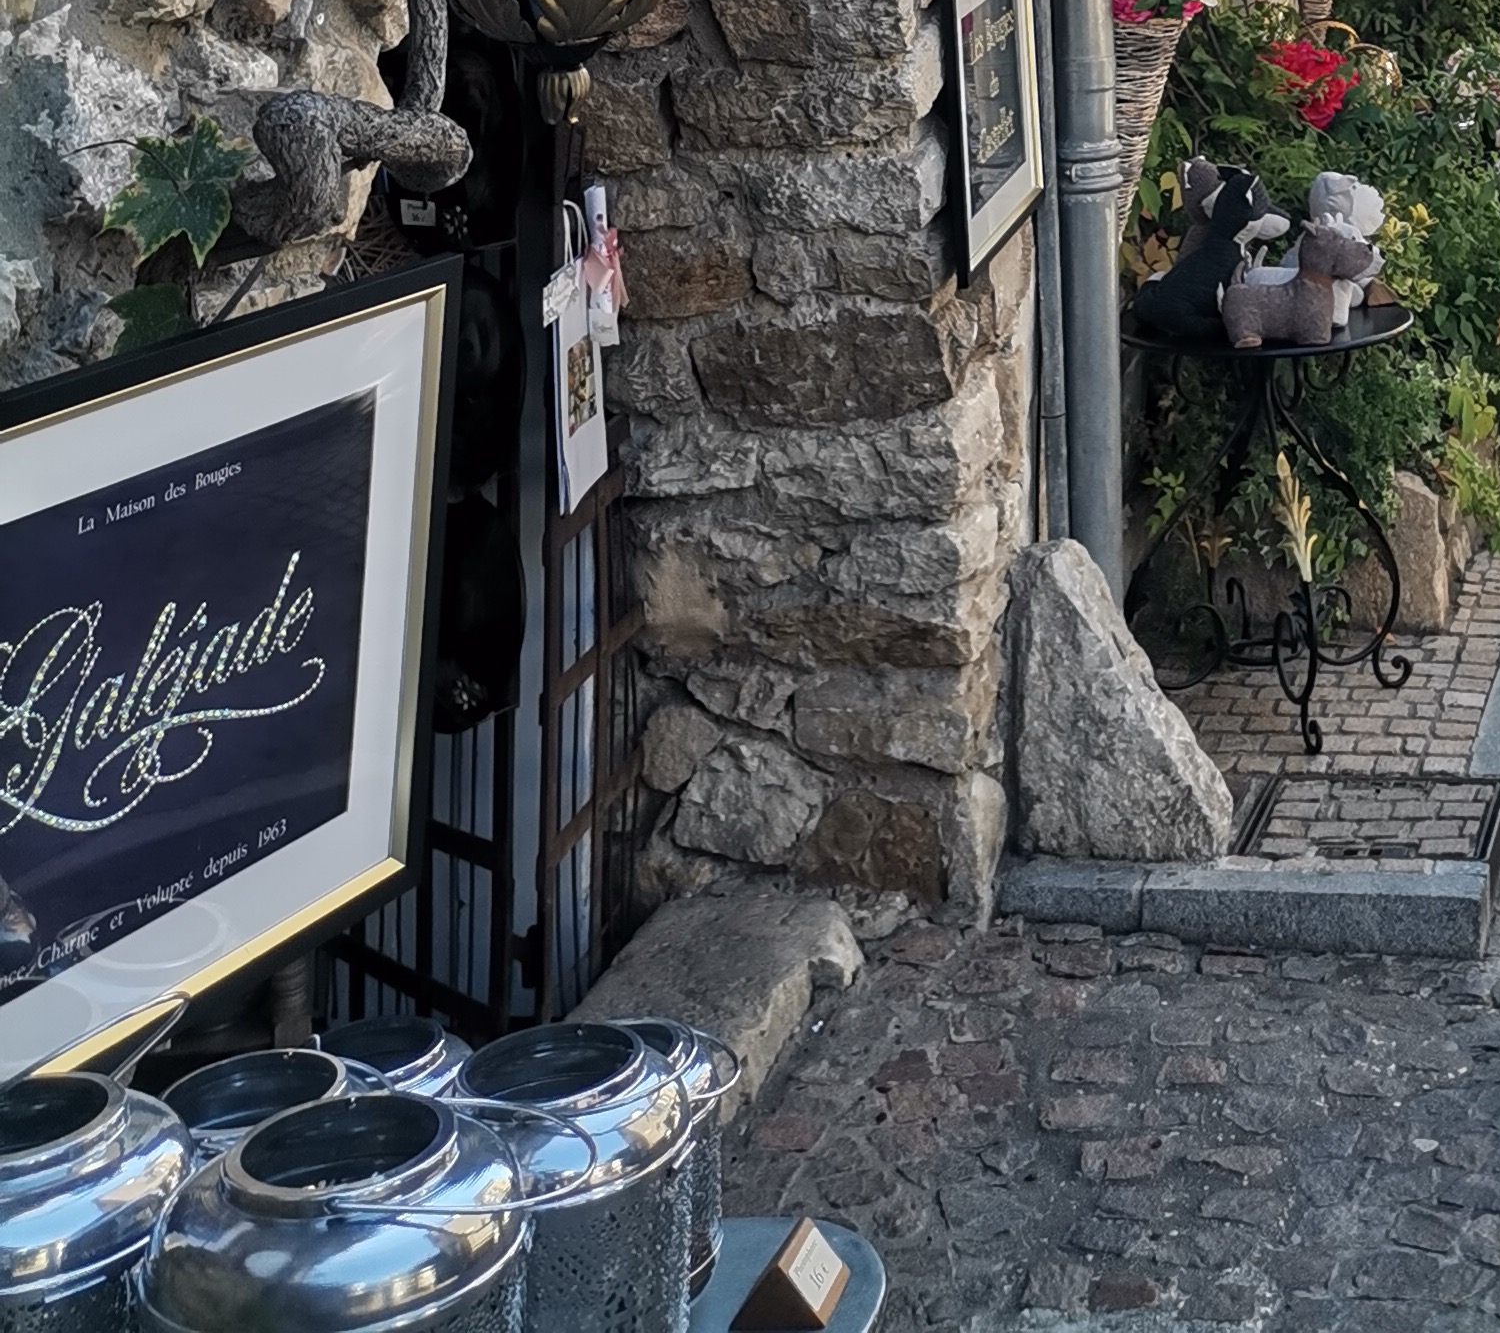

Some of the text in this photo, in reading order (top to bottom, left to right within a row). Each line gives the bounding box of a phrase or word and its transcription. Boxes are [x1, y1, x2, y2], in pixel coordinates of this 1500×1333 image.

[77, 461, 242, 535] La Maison des Bougies
[37, 925, 99, 969] Charme
[109, 910, 125, 930] et
[135, 871, 194, 914] Volupté
[203, 843, 248, 880] depuis
[257, 818, 288, 849] 1963
